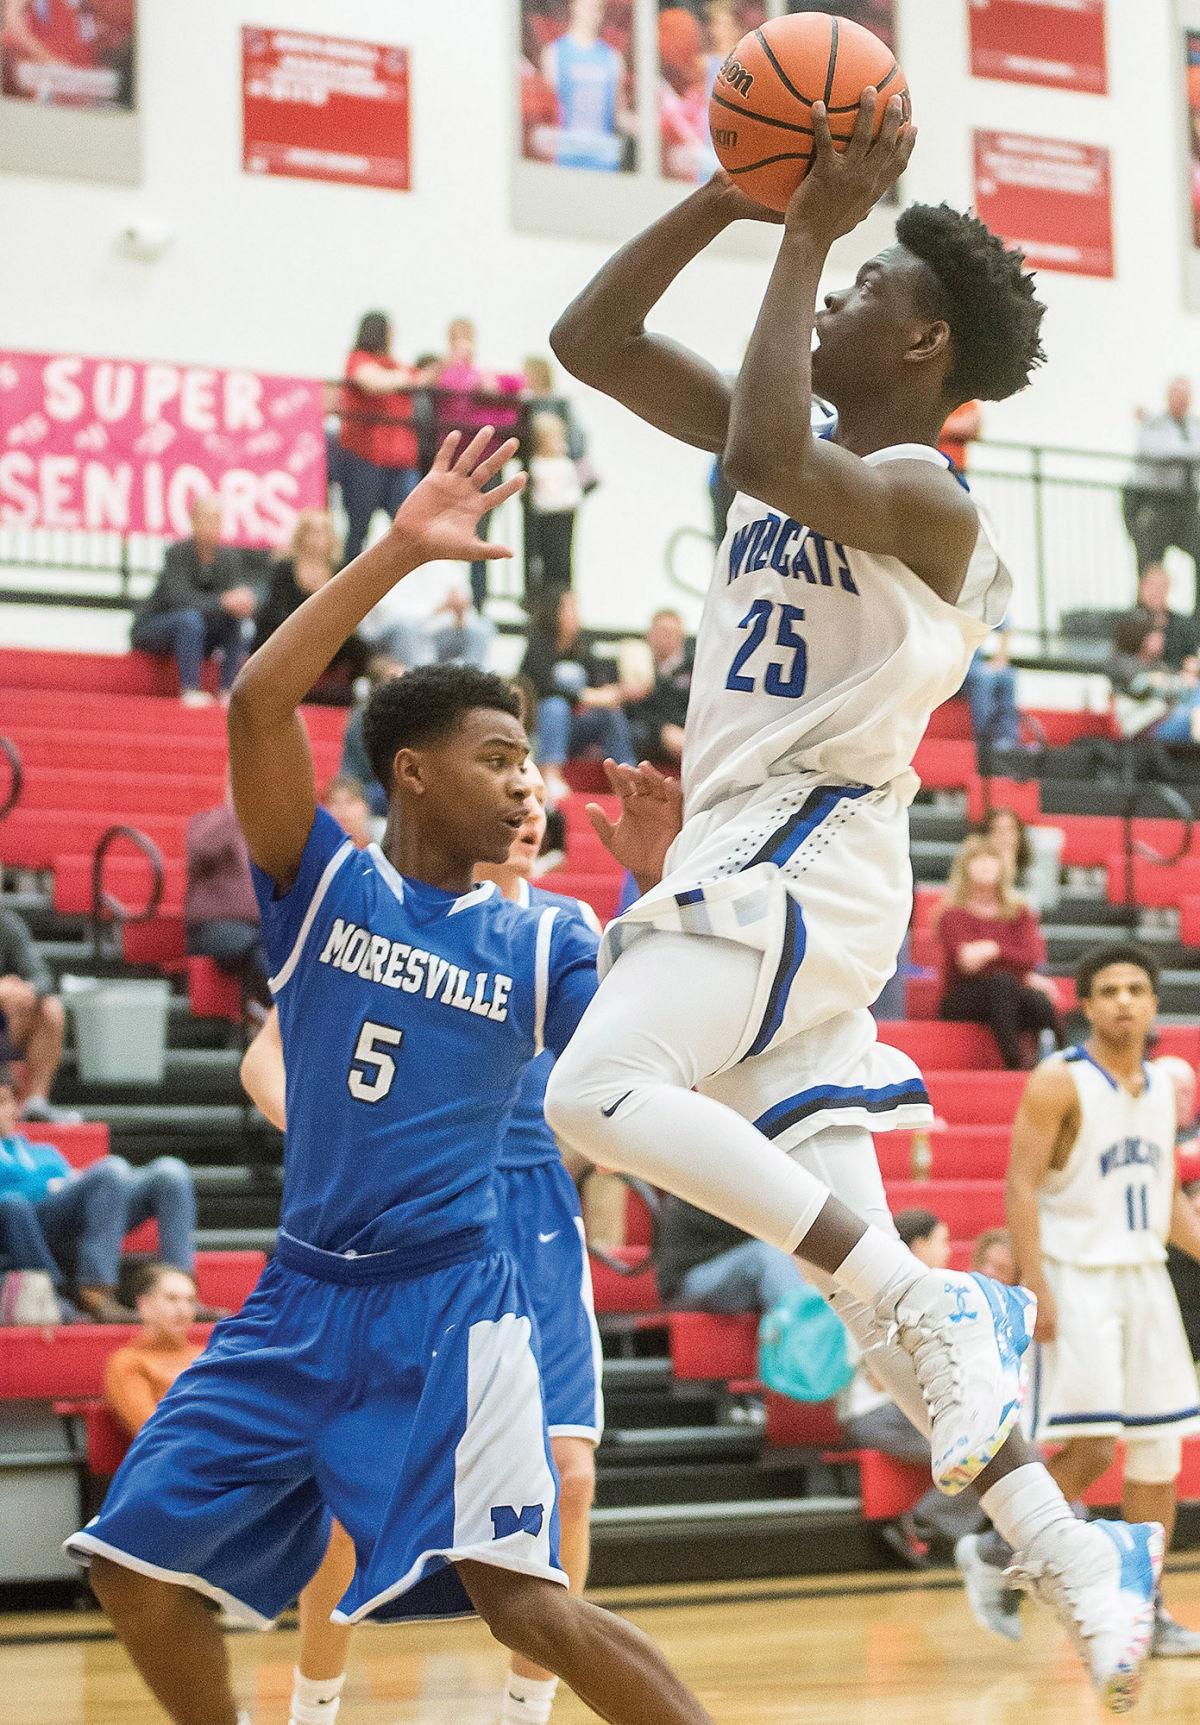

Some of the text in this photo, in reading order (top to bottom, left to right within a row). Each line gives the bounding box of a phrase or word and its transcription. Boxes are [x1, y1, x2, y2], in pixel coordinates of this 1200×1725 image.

[42, 356, 265, 433] SUPER
[0, 450, 300, 546] SENIORS
[725, 599, 807, 699] 25
[318, 917, 514, 1023] MOORESVILLE
[347, 1020, 404, 1104] 5
[1126, 1184, 1148, 1231] 11
